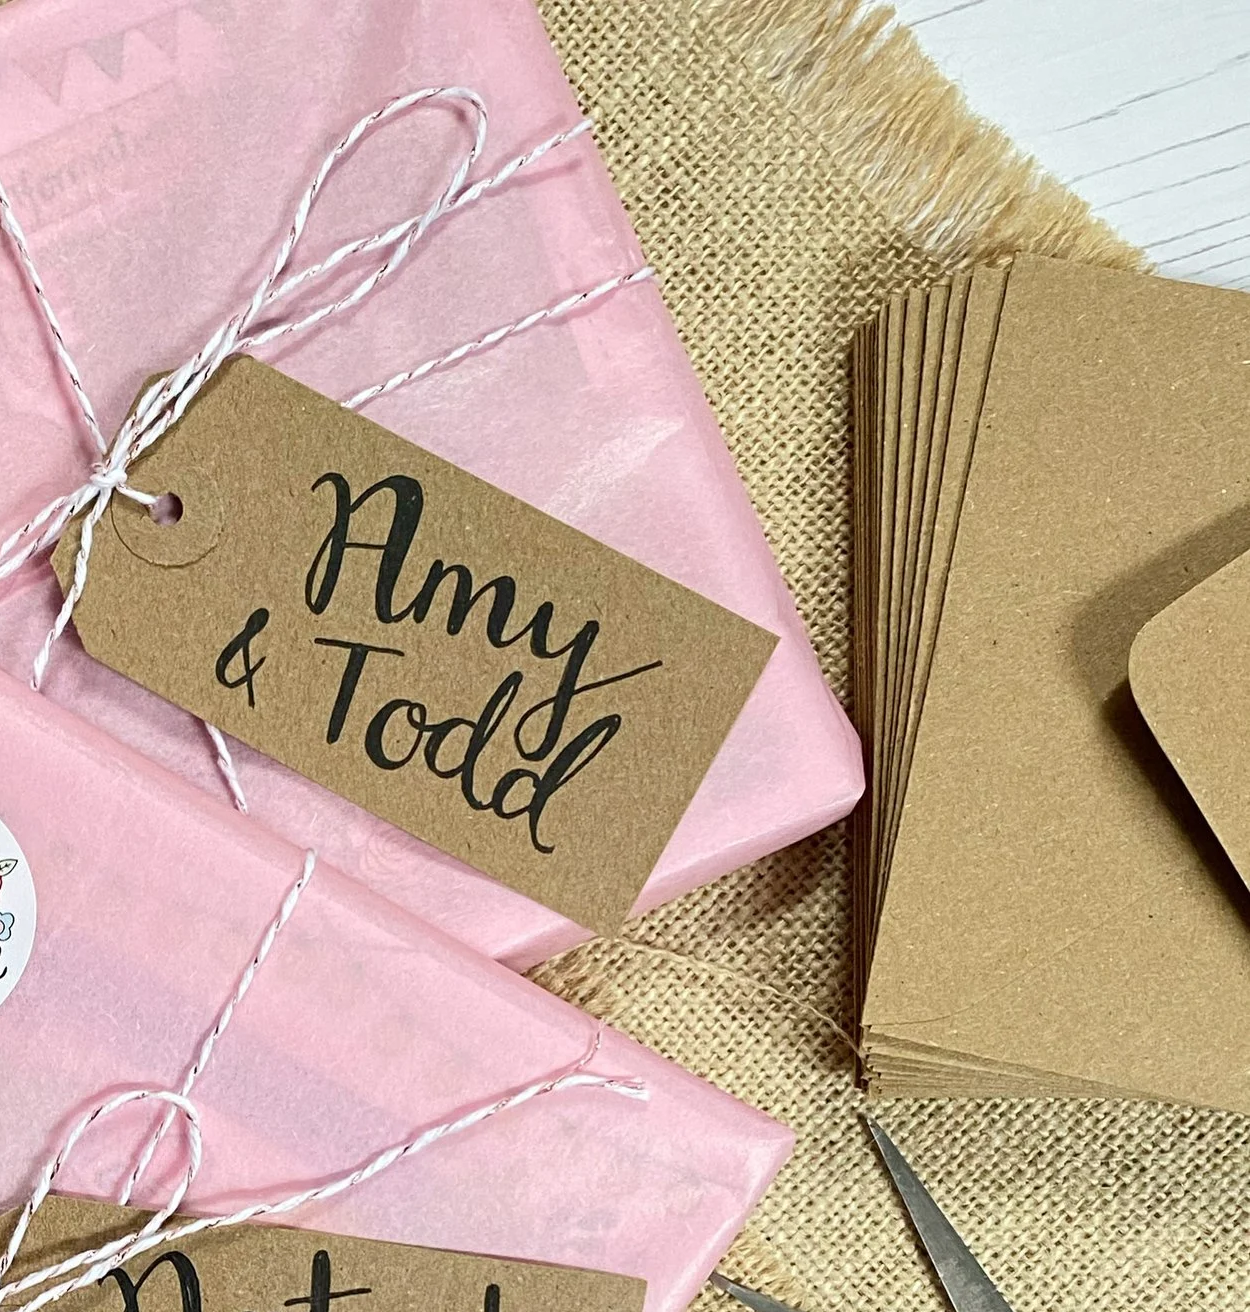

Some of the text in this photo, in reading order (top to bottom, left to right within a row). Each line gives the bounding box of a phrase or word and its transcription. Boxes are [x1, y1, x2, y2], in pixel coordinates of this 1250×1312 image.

[215, 608, 621, 854] & Todd
[305, 472, 662, 760] Amy
